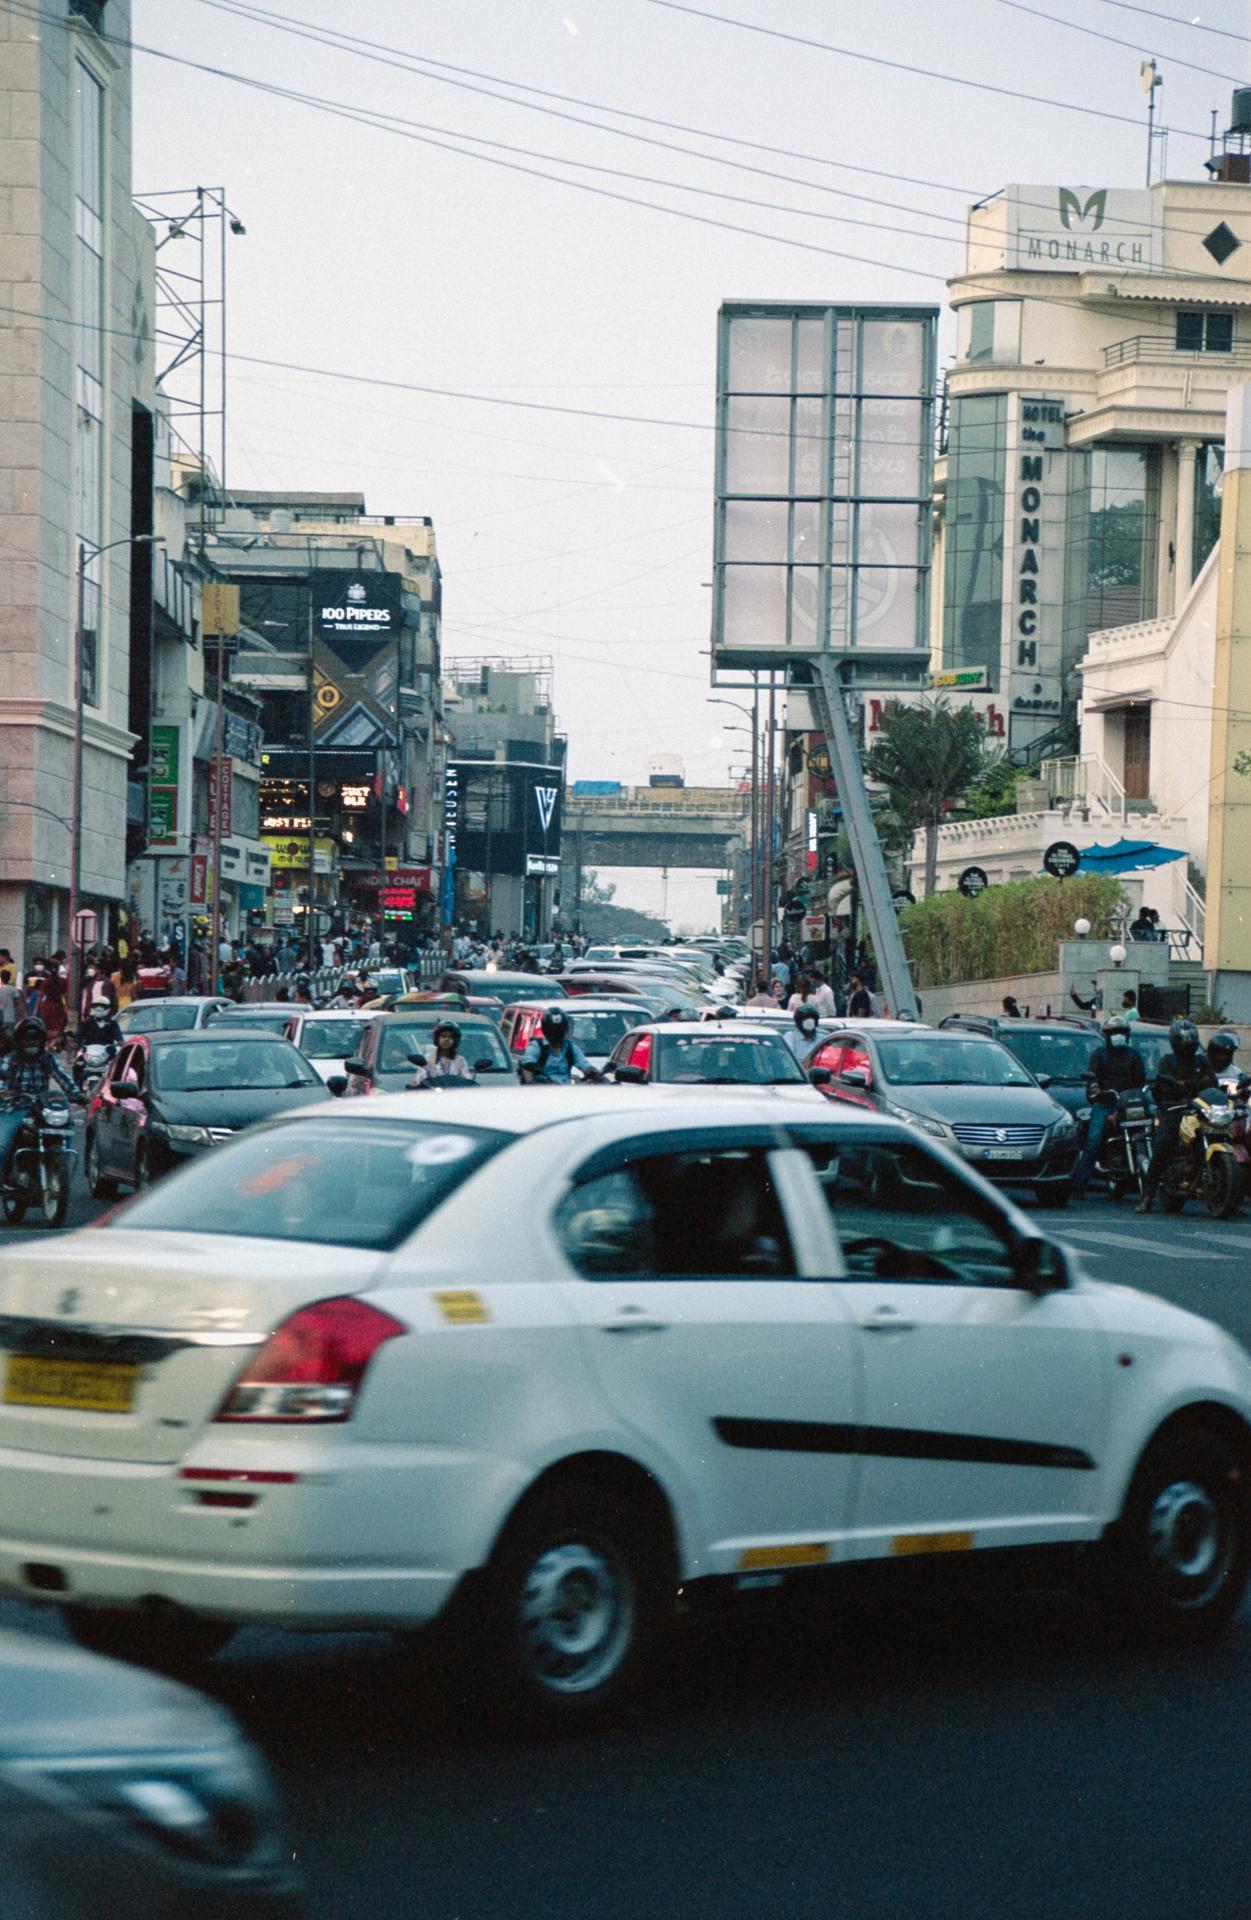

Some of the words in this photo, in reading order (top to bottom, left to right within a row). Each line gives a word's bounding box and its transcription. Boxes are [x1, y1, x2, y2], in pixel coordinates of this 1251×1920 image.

[1028, 238, 1142, 263] MONARCH
[1022, 405, 1063, 424] HOTEL
[1022, 426, 1046, 443] the
[1018, 455, 1043, 668] MONARCH
[322, 607, 345, 620] 100
[346, 606, 391, 622] PIPERS
